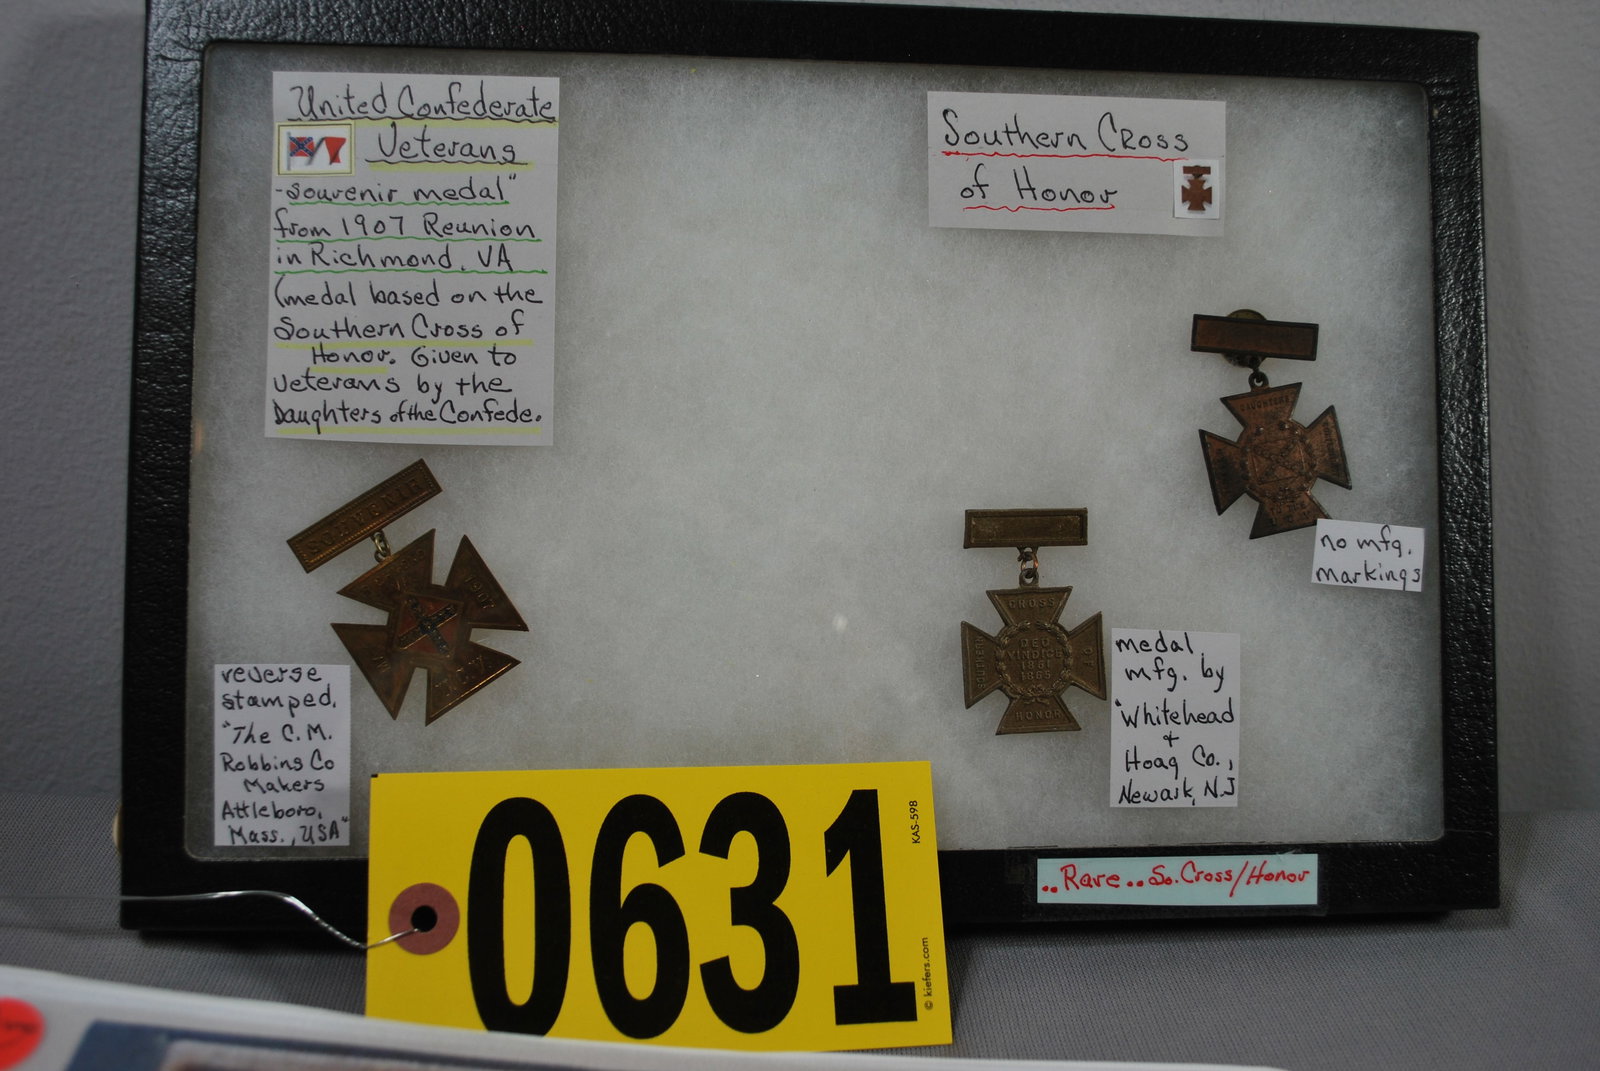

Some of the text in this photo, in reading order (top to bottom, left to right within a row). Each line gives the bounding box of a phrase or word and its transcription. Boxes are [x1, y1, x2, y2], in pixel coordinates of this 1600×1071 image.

[289, 80, 555, 119] United Confederate
[378, 121, 516, 162] Veterans
[942, 108, 1087, 149] Southern
[960, 163, 1118, 204] of Honor
[274, 208, 535, 238] from 1907 Reunion
[277, 249, 301, 265] in
[478, 243, 513, 271] VA
[275, 274, 543, 308] (medal based on the
[274, 308, 524, 340] Southern Cross of
[312, 342, 517, 367] Honor. Given to
[417, 374, 443, 404] by
[456, 372, 512, 396] the
[273, 399, 382, 435] Daughters
[1320, 524, 1412, 558] no mfg.
[1008, 597, 1056, 610] CROSS
[1115, 630, 1194, 654] medal
[221, 666, 322, 684] reverse
[1125, 653, 1224, 693] mfg. by
[1015, 709, 1063, 721] HONOR
[282, 723, 300, 742] C.
[307, 723, 332, 741] M.
[220, 749, 335, 772] Robbins Co
[1125, 745, 1178, 781] Hoag
[243, 776, 325, 794] Makers
[909, 800, 921, 844] KAS-598
[467, 789, 918, 1040] 0631
[921, 937, 933, 997] kiefers.com
